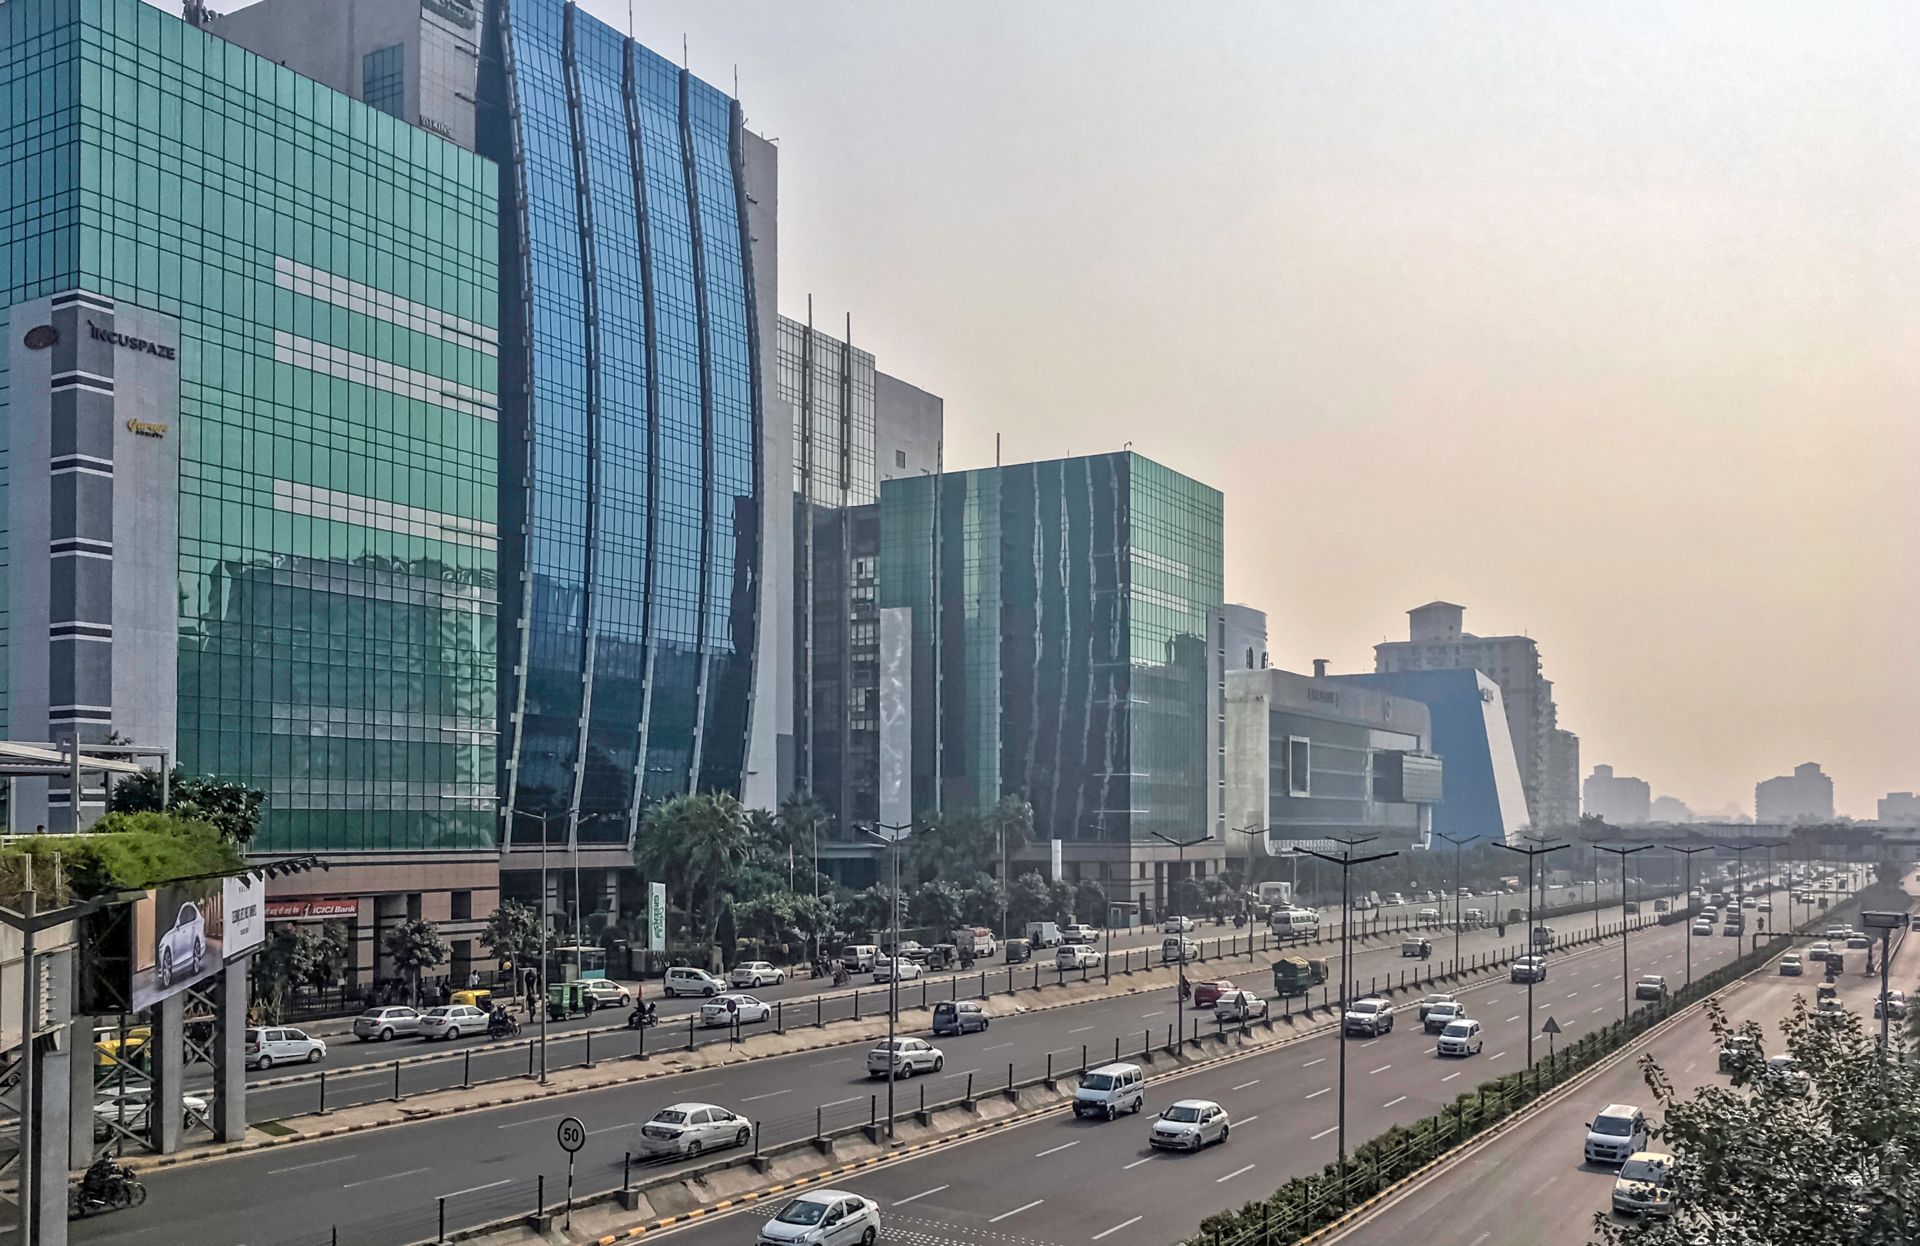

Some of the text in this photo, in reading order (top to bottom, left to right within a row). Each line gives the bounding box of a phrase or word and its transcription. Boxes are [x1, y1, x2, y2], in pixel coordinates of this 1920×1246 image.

[87, 319, 176, 361] INCUSPAZE
[312, 905, 356, 915] ICICI Bank
[563, 1127, 579, 1142] 50
